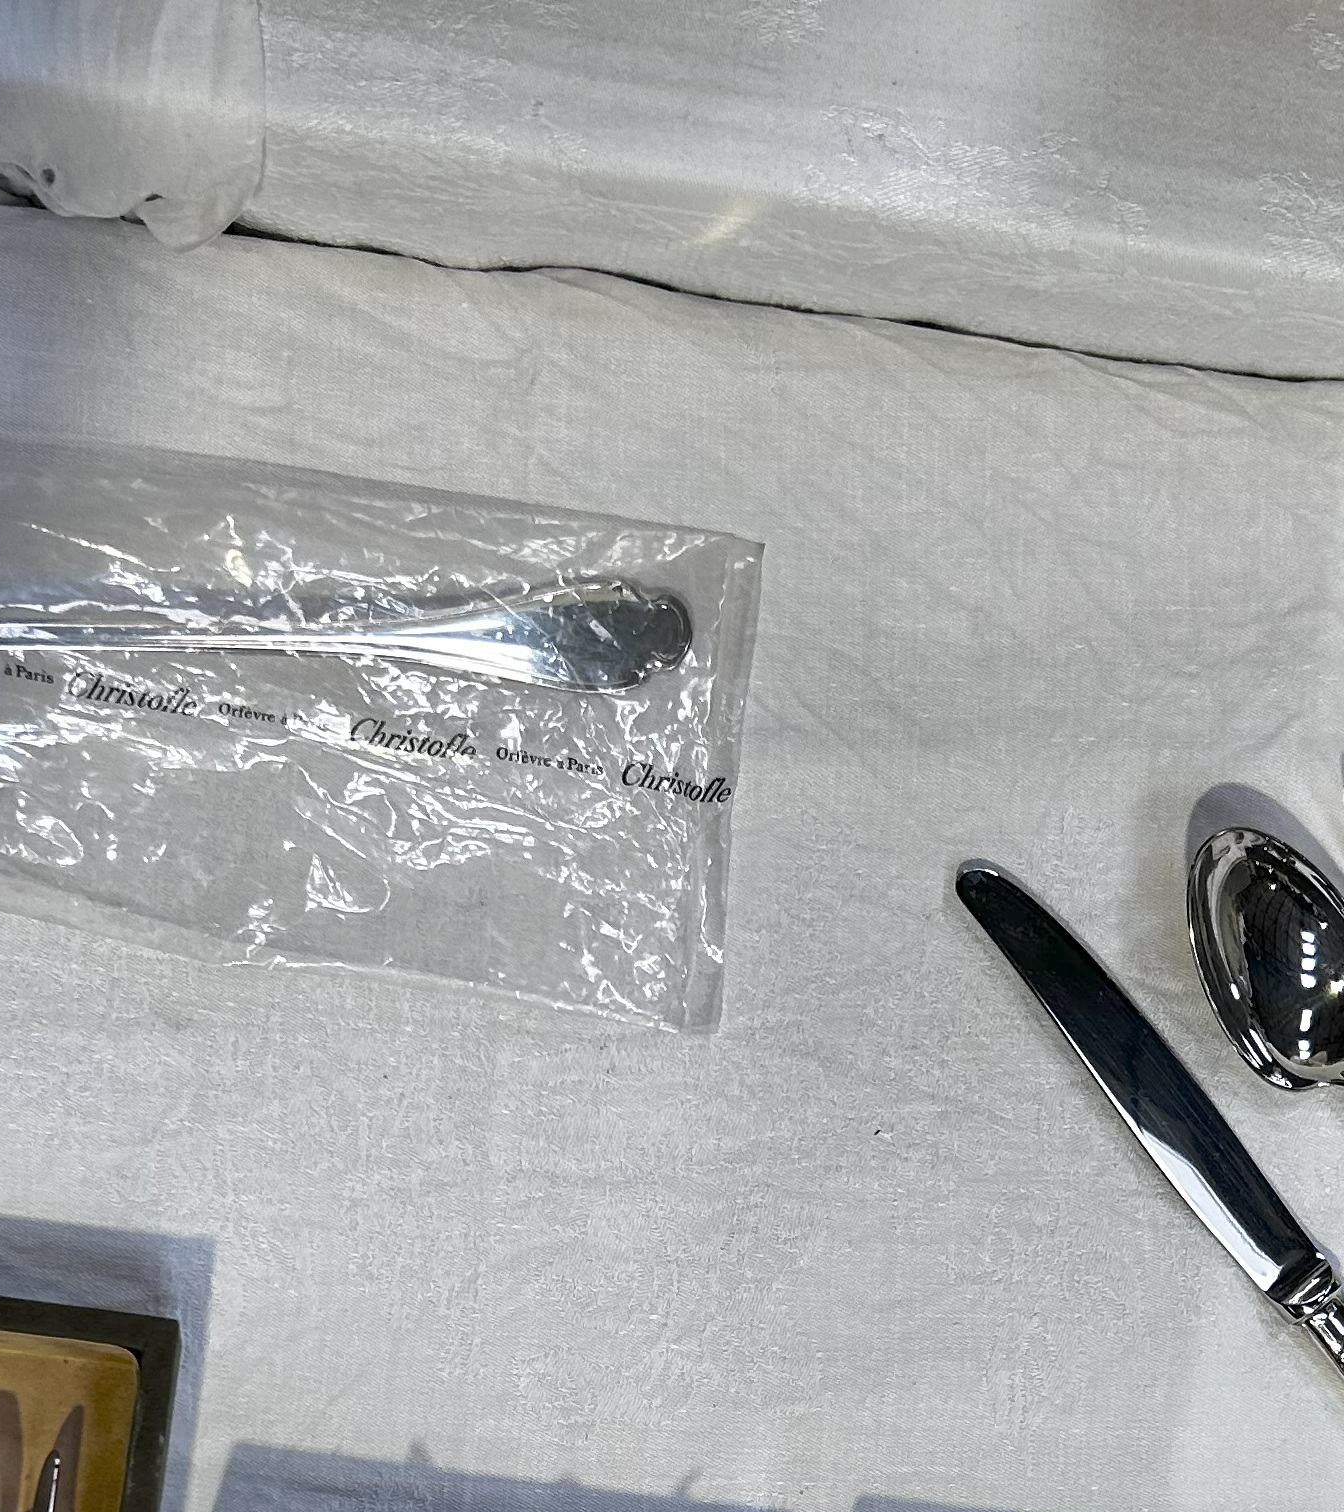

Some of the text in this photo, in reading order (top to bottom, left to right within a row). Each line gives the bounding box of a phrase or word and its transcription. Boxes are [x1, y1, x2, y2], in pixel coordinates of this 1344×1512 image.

[15, 664, 55, 685] Paris
[67, 669, 199, 717] Christofle
[218, 702, 276, 725] Orfèvre
[350, 717, 478, 762] Christofle
[566, 757, 605, 776] Paris
[620, 762, 733, 804] Christofle
